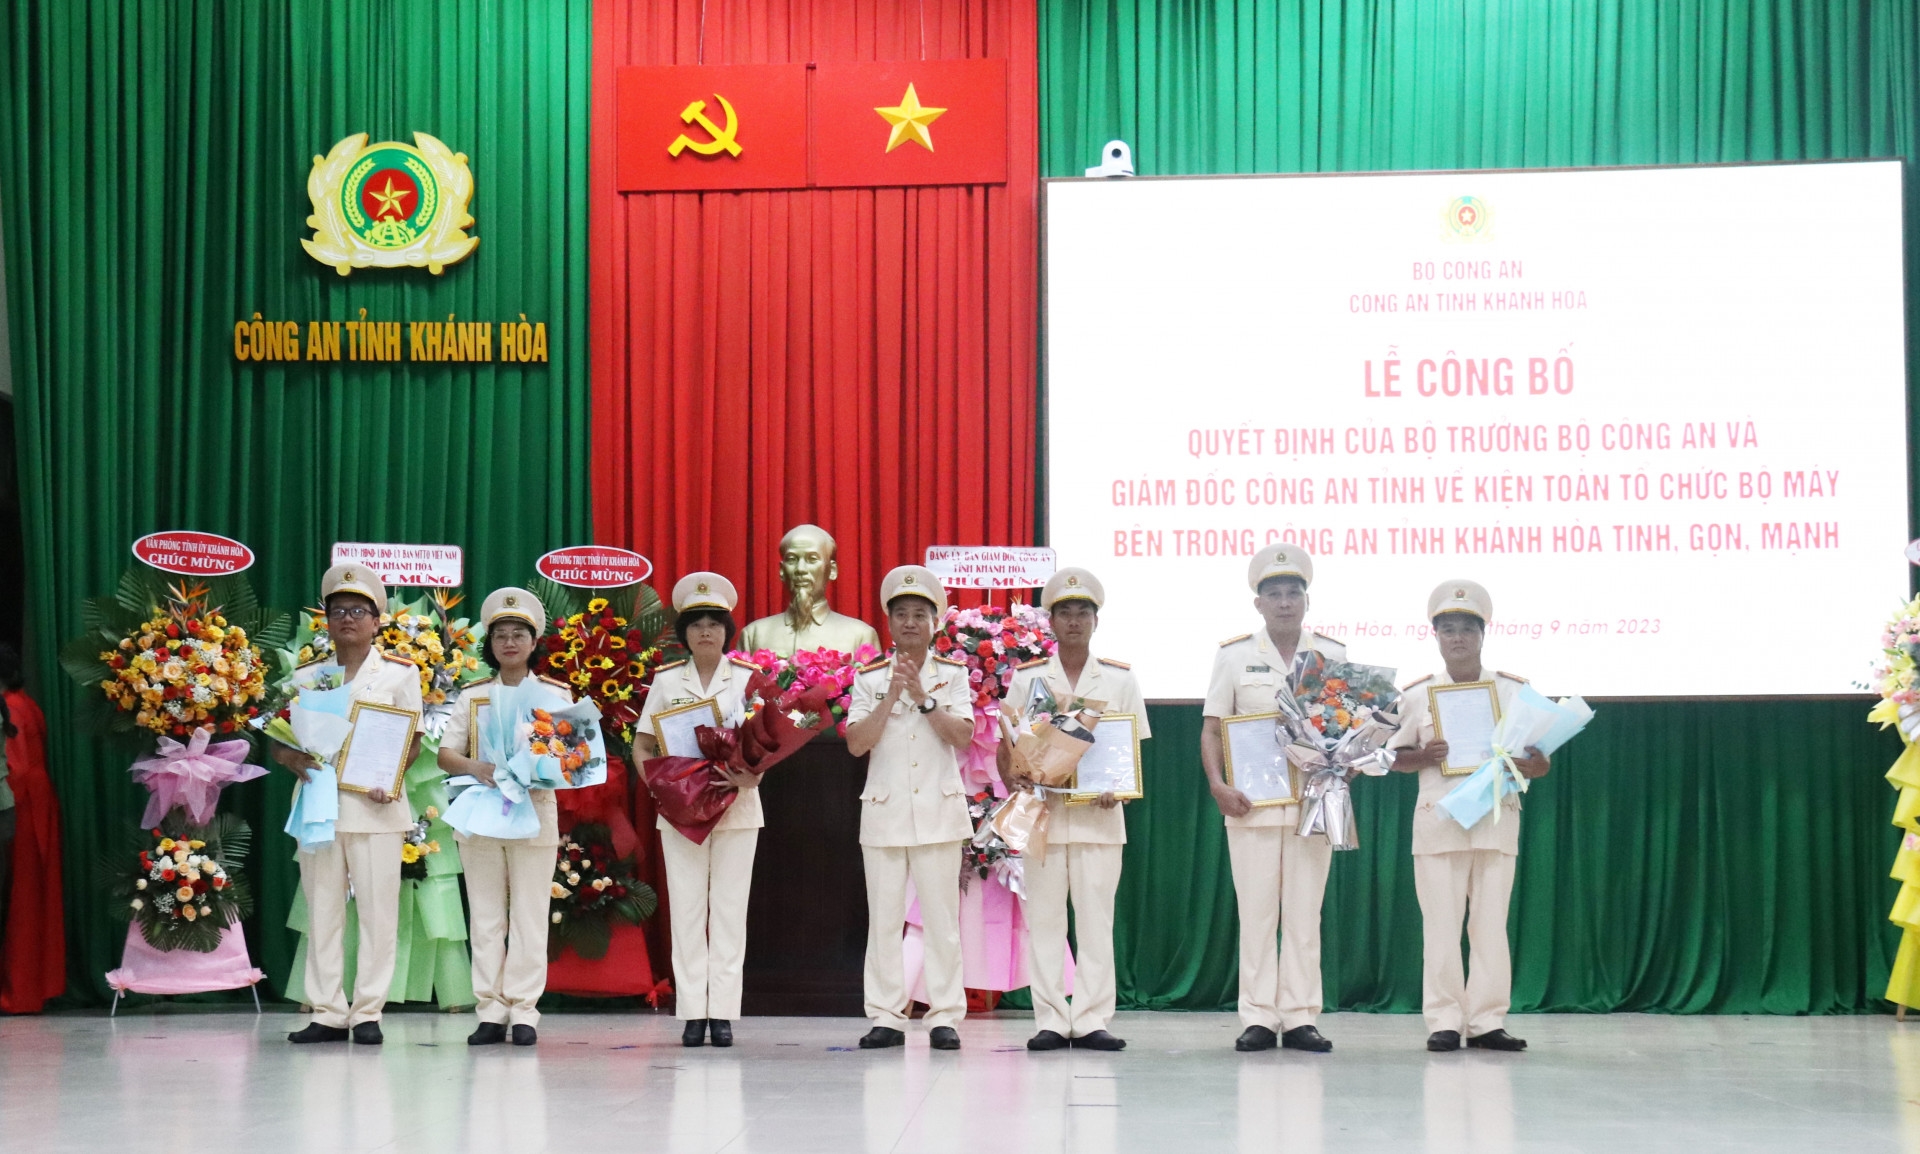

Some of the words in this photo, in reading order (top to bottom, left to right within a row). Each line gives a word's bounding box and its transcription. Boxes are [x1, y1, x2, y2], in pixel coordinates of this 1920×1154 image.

[1498, 259, 1523, 279] AN
[1405, 293, 1429, 312] AN
[234, 312, 299, 361] CÔNG
[306, 321, 341, 361] AN
[345, 308, 401, 361] TỈNH
[410, 313, 492, 362] KHÁNH
[501, 313, 548, 362] HÒA
[1364, 344, 1402, 398] LỄ
[1416, 349, 1514, 397] CÔNG
[1528, 341, 1574, 396] BỐ
[1187, 419, 1265, 459] QUYẾT
[1274, 427, 1335, 462] ĐỊNH
[1344, 417, 1394, 455] CỦA
[1404, 419, 1437, 460] BỘ
[1446, 416, 1548, 453] TRƯỞNG
[1557, 417, 1590, 458] BỘ
[1601, 416, 1671, 451] CÔNG
[1681, 421, 1716, 449] AN
[1726, 414, 1759, 449] VÀ
[1111, 472, 1176, 506] GIÁM
[1185, 468, 1236, 506] ĐỐC
[1245, 472, 1314, 506] CÔNG
[1324, 477, 1358, 505] AN
[1368, 466, 1425, 504] TỈNH
[1474, 468, 1533, 510] KIỆN
[1542, 468, 1609, 502] TOÀN
[1659, 465, 1728, 501] CHỨC
[1738, 464, 1772, 505] BỘ
[1783, 463, 1840, 498] MÁY
[1113, 523, 1163, 557] BÊN
[1172, 528, 1255, 557] TRONG
[1343, 527, 1378, 555] AN
[1387, 517, 1444, 555] TỈNH
[1455, 519, 1542, 554] KHÁNH
[1552, 518, 1603, 553] HÒA
[1612, 524, 1679, 555] TINH,
[1689, 522, 1750, 557] GỌN,
[1761, 521, 1839, 556] MẠNH
[159, 538, 181, 551] PHÒNG
[182, 539, 198, 552] TỈNH
[208, 542, 230, 556] KHÁNH
[230, 544, 244, 557] HÒA
[403, 549, 413, 559] BAN
[445, 550, 457, 560] NAM
[148, 552, 187, 566] CHÚC
[191, 556, 235, 571] MỪNG
[609, 554, 628, 567] KHÁNH
[628, 555, 640, 567] HÒA
[399, 572, 452, 584] MỪNG
[551, 567, 588, 580] CHÚC
[591, 568, 633, 581] MỪNG
[1549, 619, 1560, 634] 9
[1616, 618, 1661, 634] 2023
